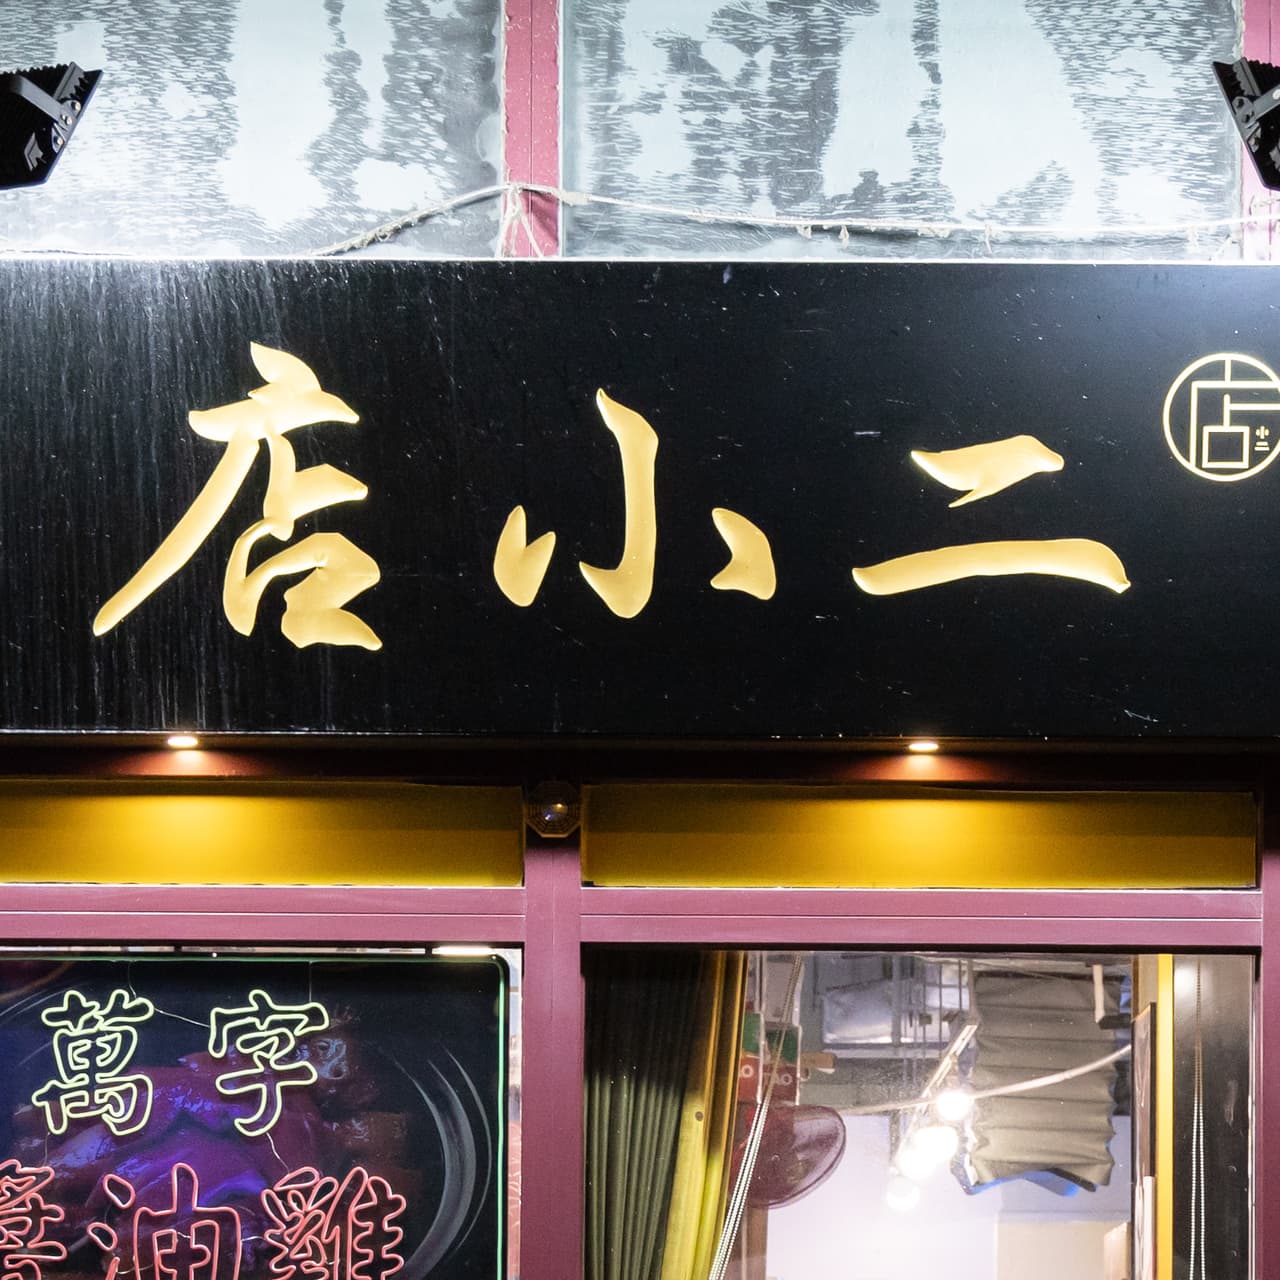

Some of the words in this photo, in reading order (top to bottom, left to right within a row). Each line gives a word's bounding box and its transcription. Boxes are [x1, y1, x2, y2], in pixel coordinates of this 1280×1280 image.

[93, 341, 1132, 650] 店小二
[32, 989, 328, 1136] 萬字
